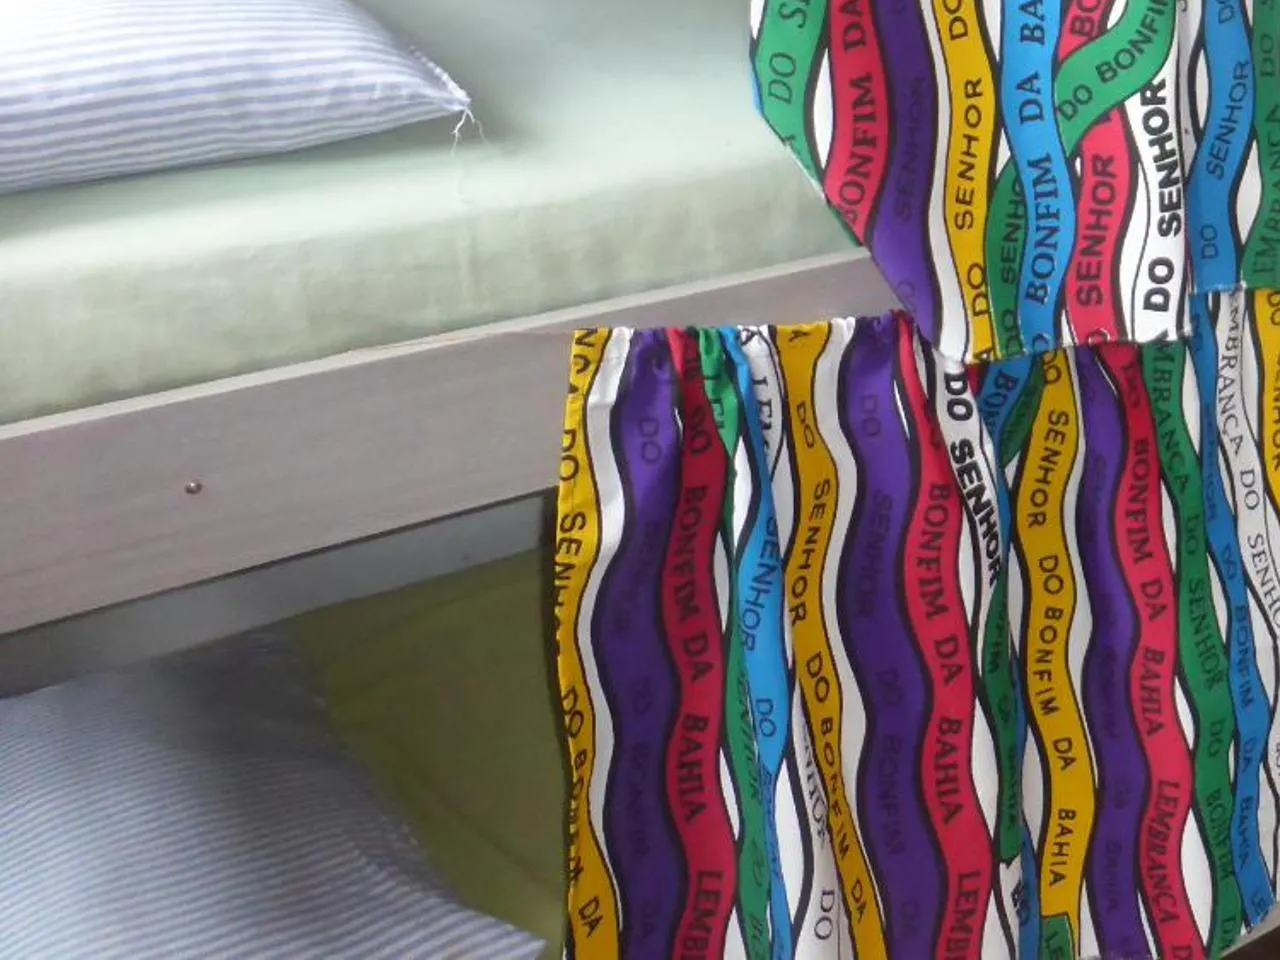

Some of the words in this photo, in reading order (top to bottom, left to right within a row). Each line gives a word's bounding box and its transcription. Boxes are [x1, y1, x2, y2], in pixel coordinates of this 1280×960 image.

[768, 53, 797, 104] DO
[1016, 70, 1043, 125] DA
[1057, 82, 1093, 122] DO
[955, 78, 985, 230] SENHOR
[1203, 58, 1250, 182] SENHOR
[1139, 75, 1183, 240] SENHOR
[1024, 152, 1060, 305] BONFIM
[1077, 154, 1117, 308] SENHOR
[1200, 223, 1220, 262] DO
[967, 262, 989, 317] DO
[1143, 256, 1176, 314] DO
[797, 402, 815, 450] DO
[943, 371, 973, 423] DO
[640, 420, 662, 464] DO
[1028, 409, 1070, 529] SENHOR
[950, 438, 1002, 585] SENHOR
[1122, 435, 1155, 565] BONFIM
[1241, 468, 1259, 510] DO
[673, 485, 708, 622] BONFIM
[742, 514, 781, 652] SENHOR
[789, 478, 832, 626] SENHOR
[917, 483, 950, 620] BONFIM
[1039, 555, 1063, 596] DO
[1140, 580, 1166, 620] DA
[683, 632, 714, 682] DA
[934, 634, 964, 686] DA
[1034, 608, 1064, 716] BONFIM
[1188, 580, 1222, 690] SENHOR
[1234, 606, 1254, 708] BONFIM
[806, 652, 830, 702] DO
[1140, 647, 1165, 736] BAHIA
[757, 698, 778, 738] DO
[676, 713, 708, 822] BAHIA
[934, 720, 963, 825] BAHIA
[1053, 737, 1077, 770] DA
[822, 718, 848, 862] BONFIM
[1049, 808, 1077, 886] BAHIA
[578, 895, 604, 938] DA
[820, 890, 836, 940] DO
[852, 880, 867, 924] DA
